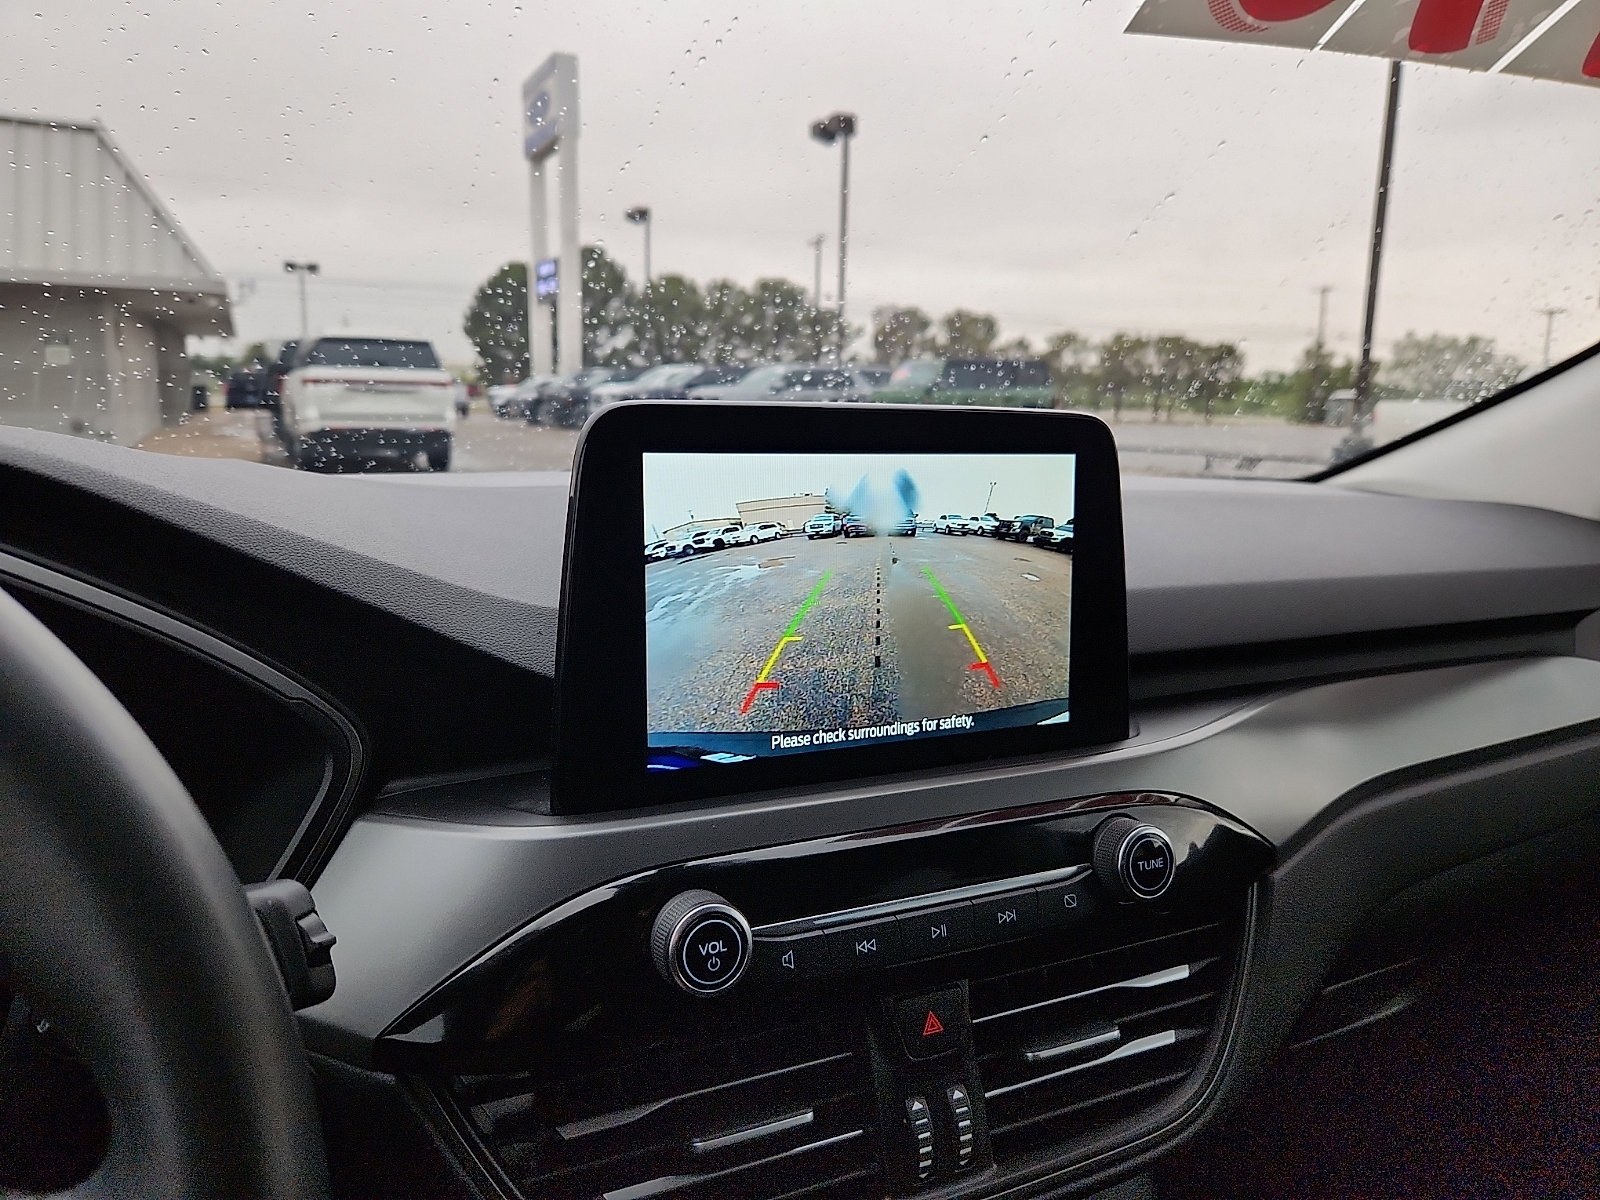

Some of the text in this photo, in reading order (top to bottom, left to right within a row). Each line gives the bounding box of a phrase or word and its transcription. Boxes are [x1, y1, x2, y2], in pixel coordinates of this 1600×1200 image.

[771, 713, 975, 750] Please check surroundings for safety.
[1138, 857, 1164, 871] TUNE
[698, 940, 728, 956] VOL
